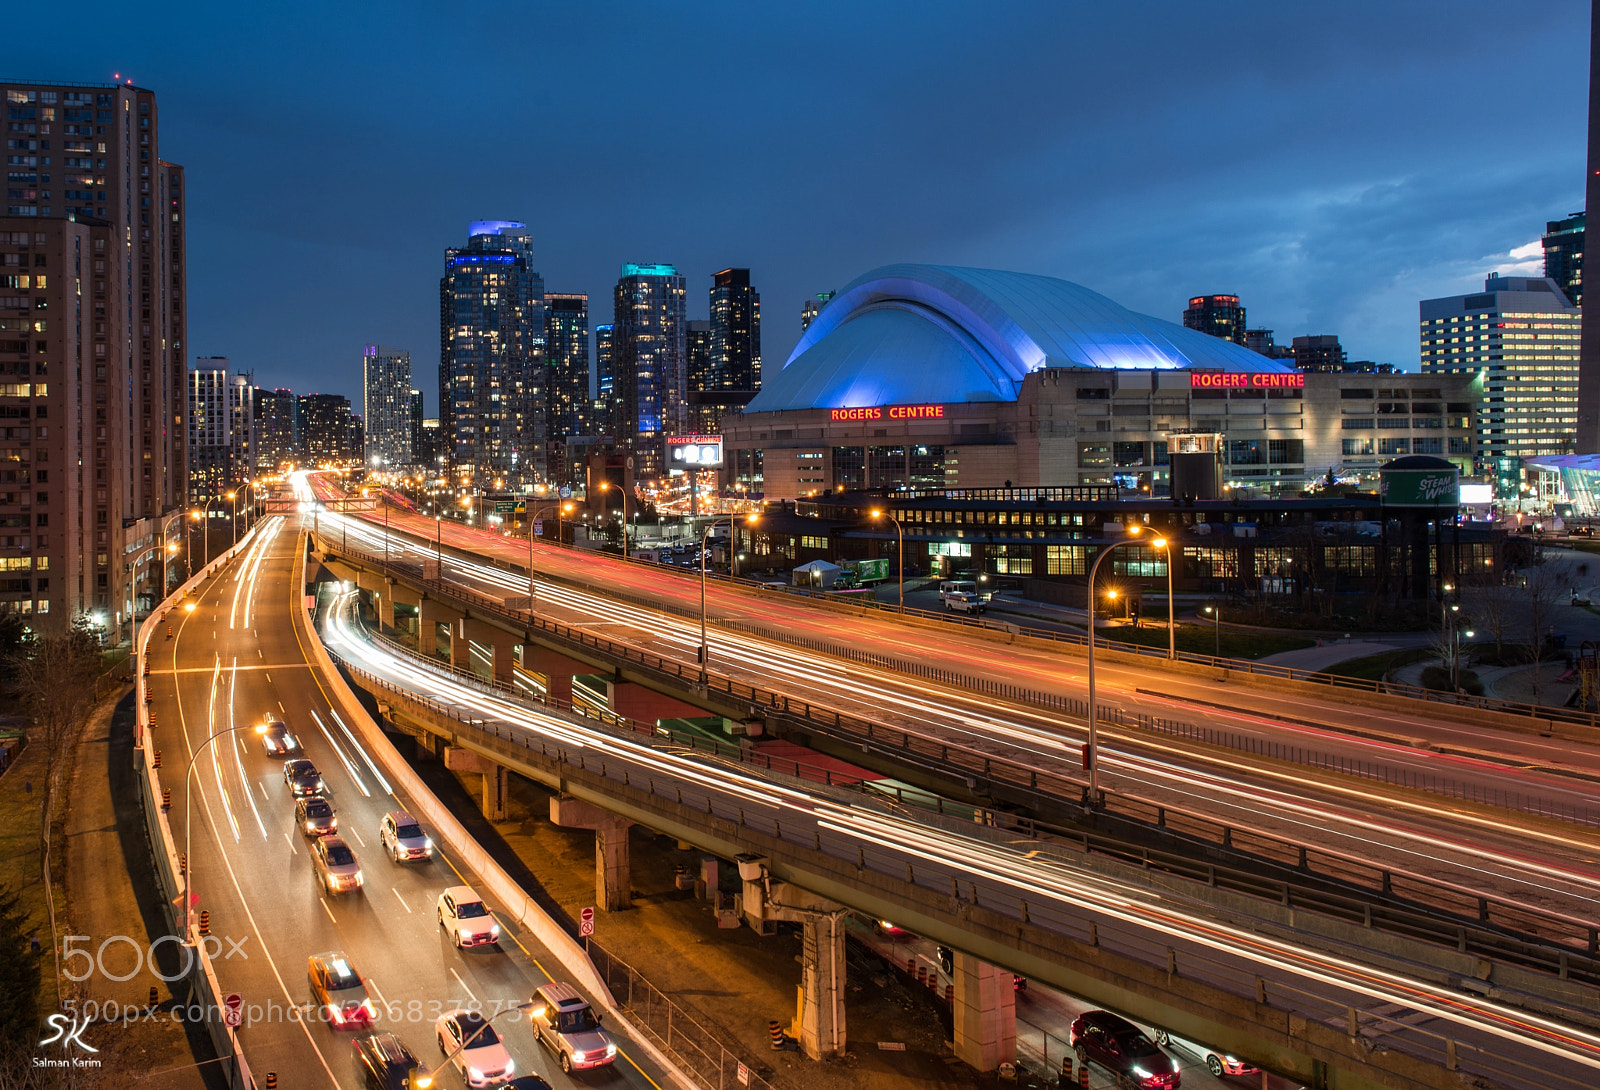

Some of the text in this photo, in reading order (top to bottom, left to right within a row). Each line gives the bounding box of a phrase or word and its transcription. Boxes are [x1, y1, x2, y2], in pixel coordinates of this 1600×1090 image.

[1191, 373, 1304, 387] ROGERS CENTRE
[831, 405, 944, 421] ROGERS CENTRE
[667, 436, 695, 444] ROGERS
[1419, 476, 1451, 491] STEAM
